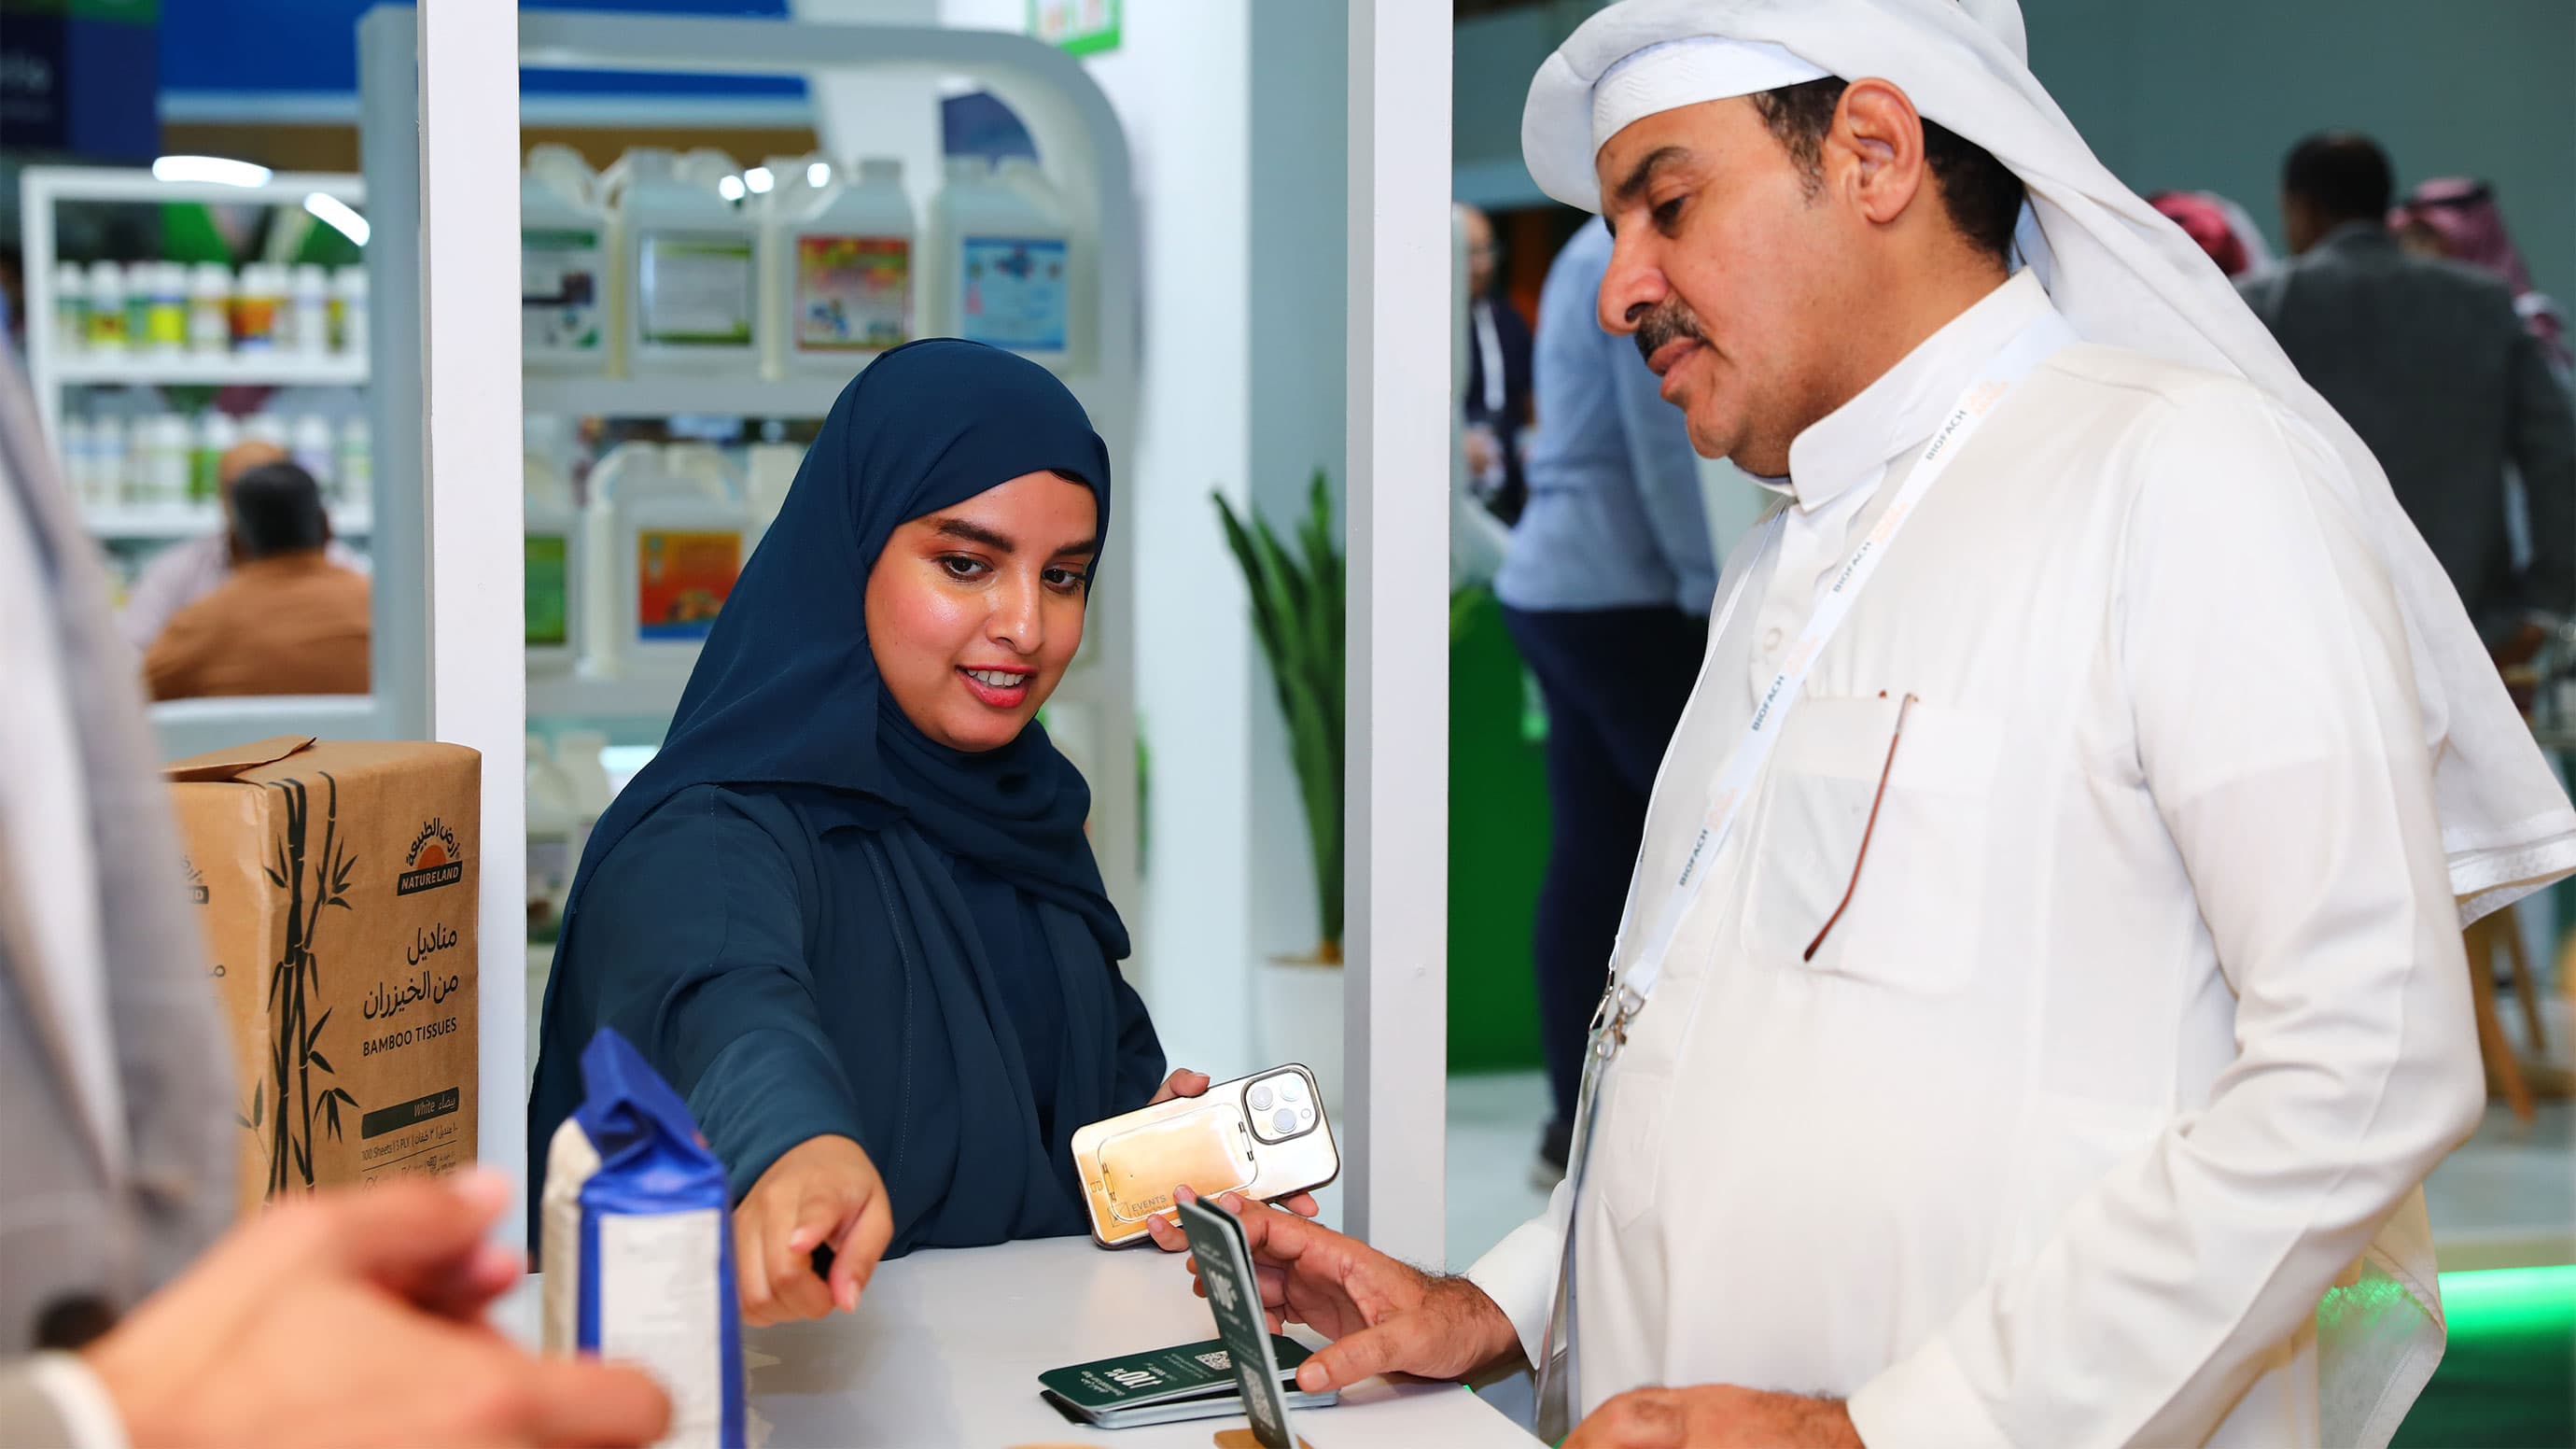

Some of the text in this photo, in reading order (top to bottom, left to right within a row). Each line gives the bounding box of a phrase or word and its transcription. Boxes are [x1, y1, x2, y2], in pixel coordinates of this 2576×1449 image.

[1925, 410, 1967, 460] BIOFACH
[1832, 542, 1871, 593] BIOFACH
[1751, 675, 1785, 731] BIOFACH
[400, 865, 459, 891] NATURELAND
[1679, 828, 1708, 886] BIOFACH
[407, 921, 457, 965] مناديل
[363, 970, 458, 1020] من الخيزران
[363, 1017, 456, 1057] BAMBOO TISSUES
[413, 1099, 436, 1118] White
[439, 1093, 455, 1109] بيضاء
[1131, 1194, 1166, 1212] EVENTS
